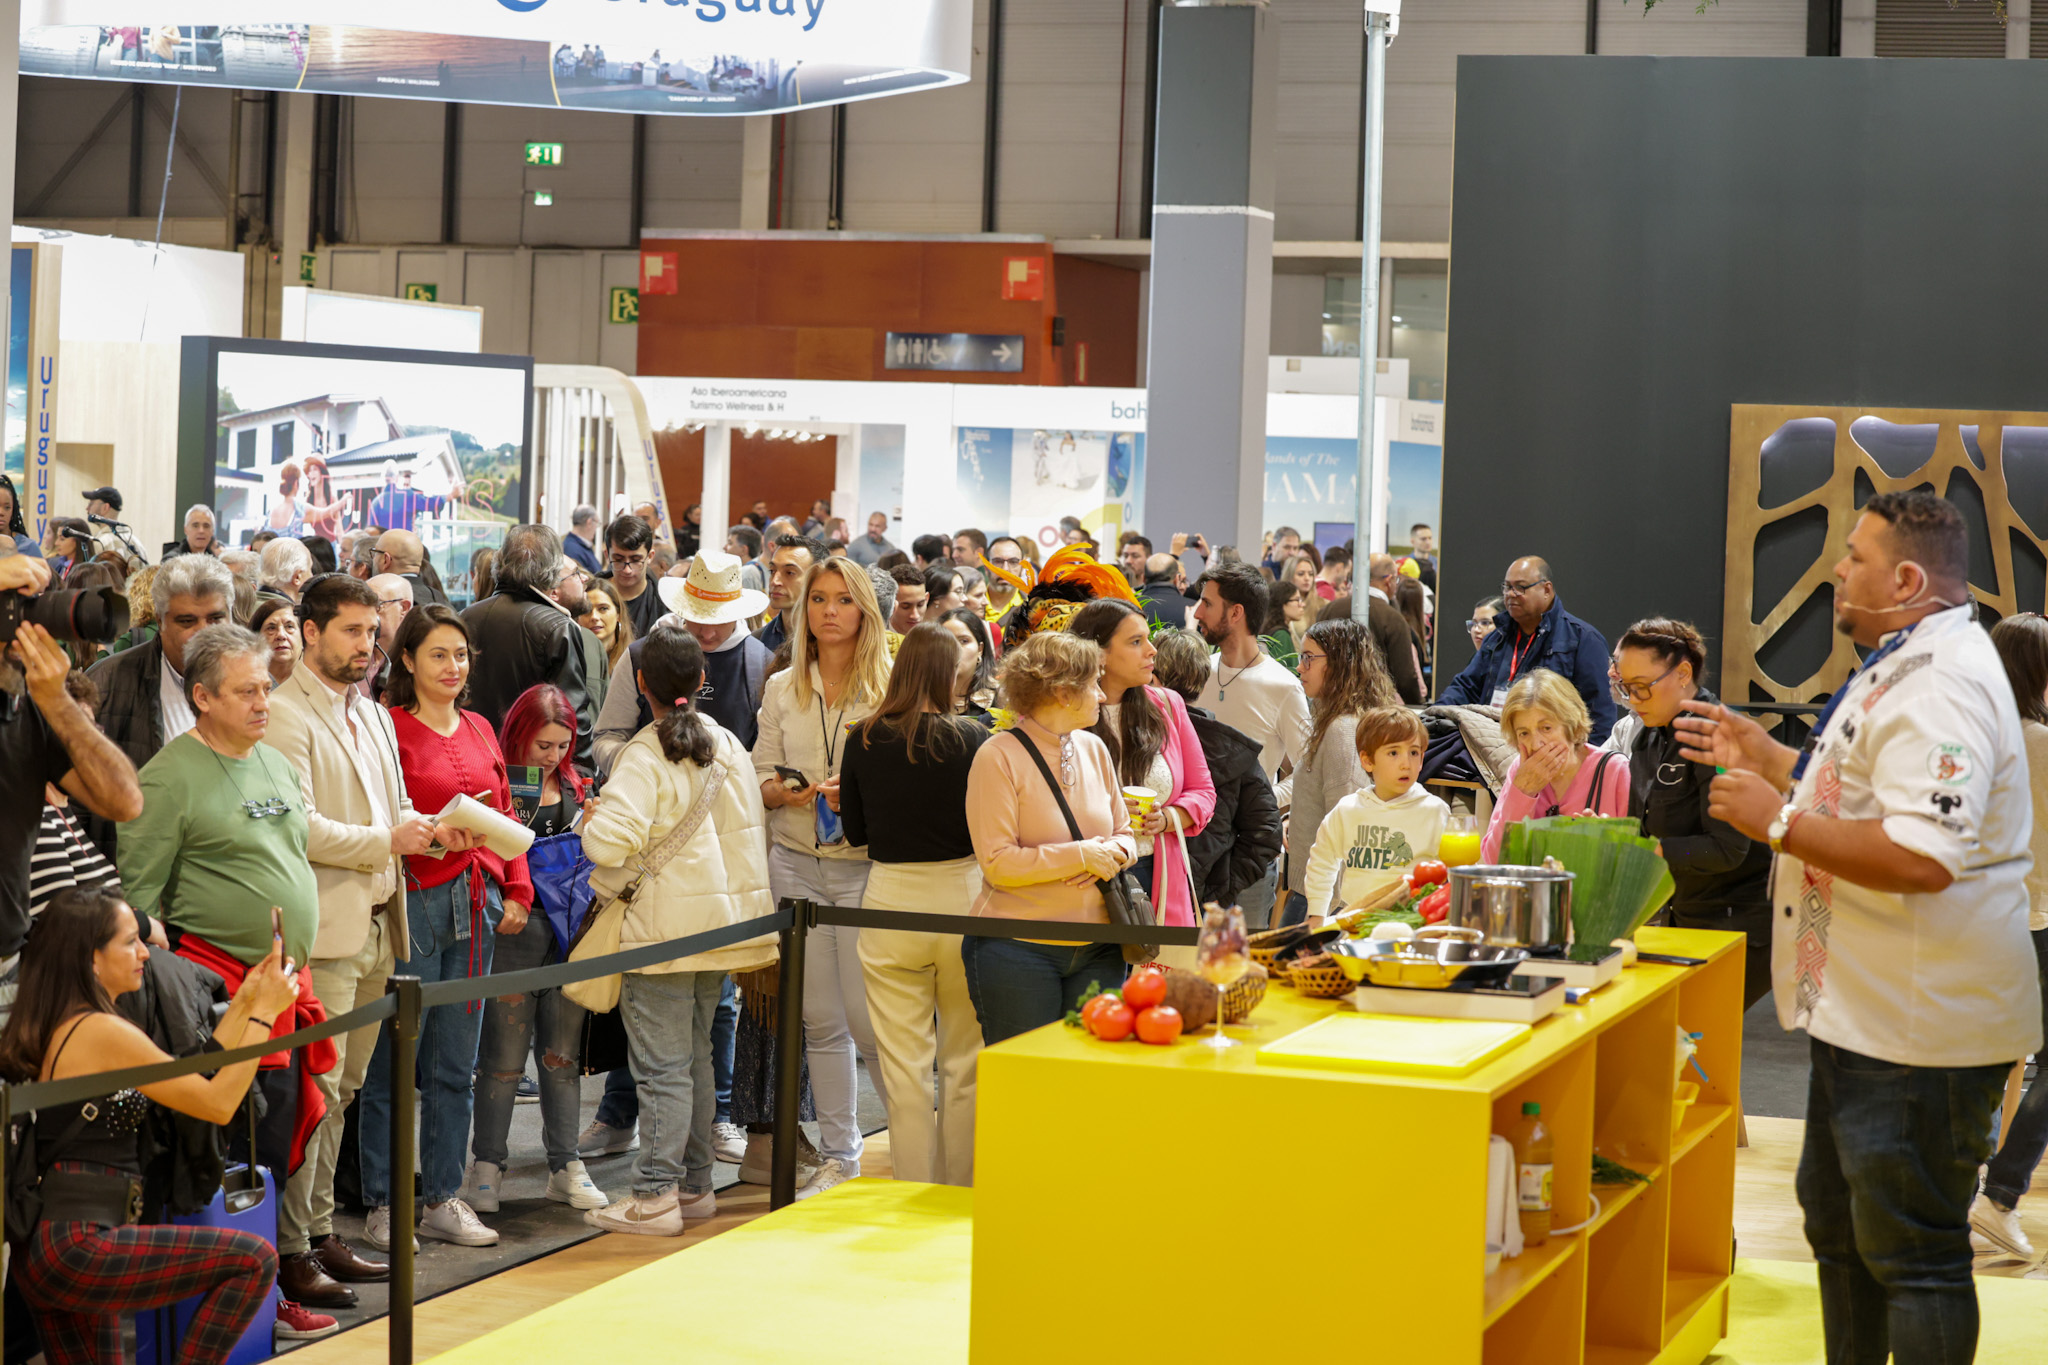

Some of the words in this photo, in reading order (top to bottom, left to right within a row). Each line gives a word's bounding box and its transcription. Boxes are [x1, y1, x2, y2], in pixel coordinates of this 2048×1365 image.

[692, 386, 708, 397] Aso
[711, 387, 788, 399] Iberoamericana
[690, 399, 724, 410] Turismo
[726, 401, 765, 412] Wellness
[36, 356, 53, 547] Uruguay
[1317, 452, 1341, 466] The
[1354, 825, 1390, 848] JUST
[1346, 846, 1392, 870] SKATE
